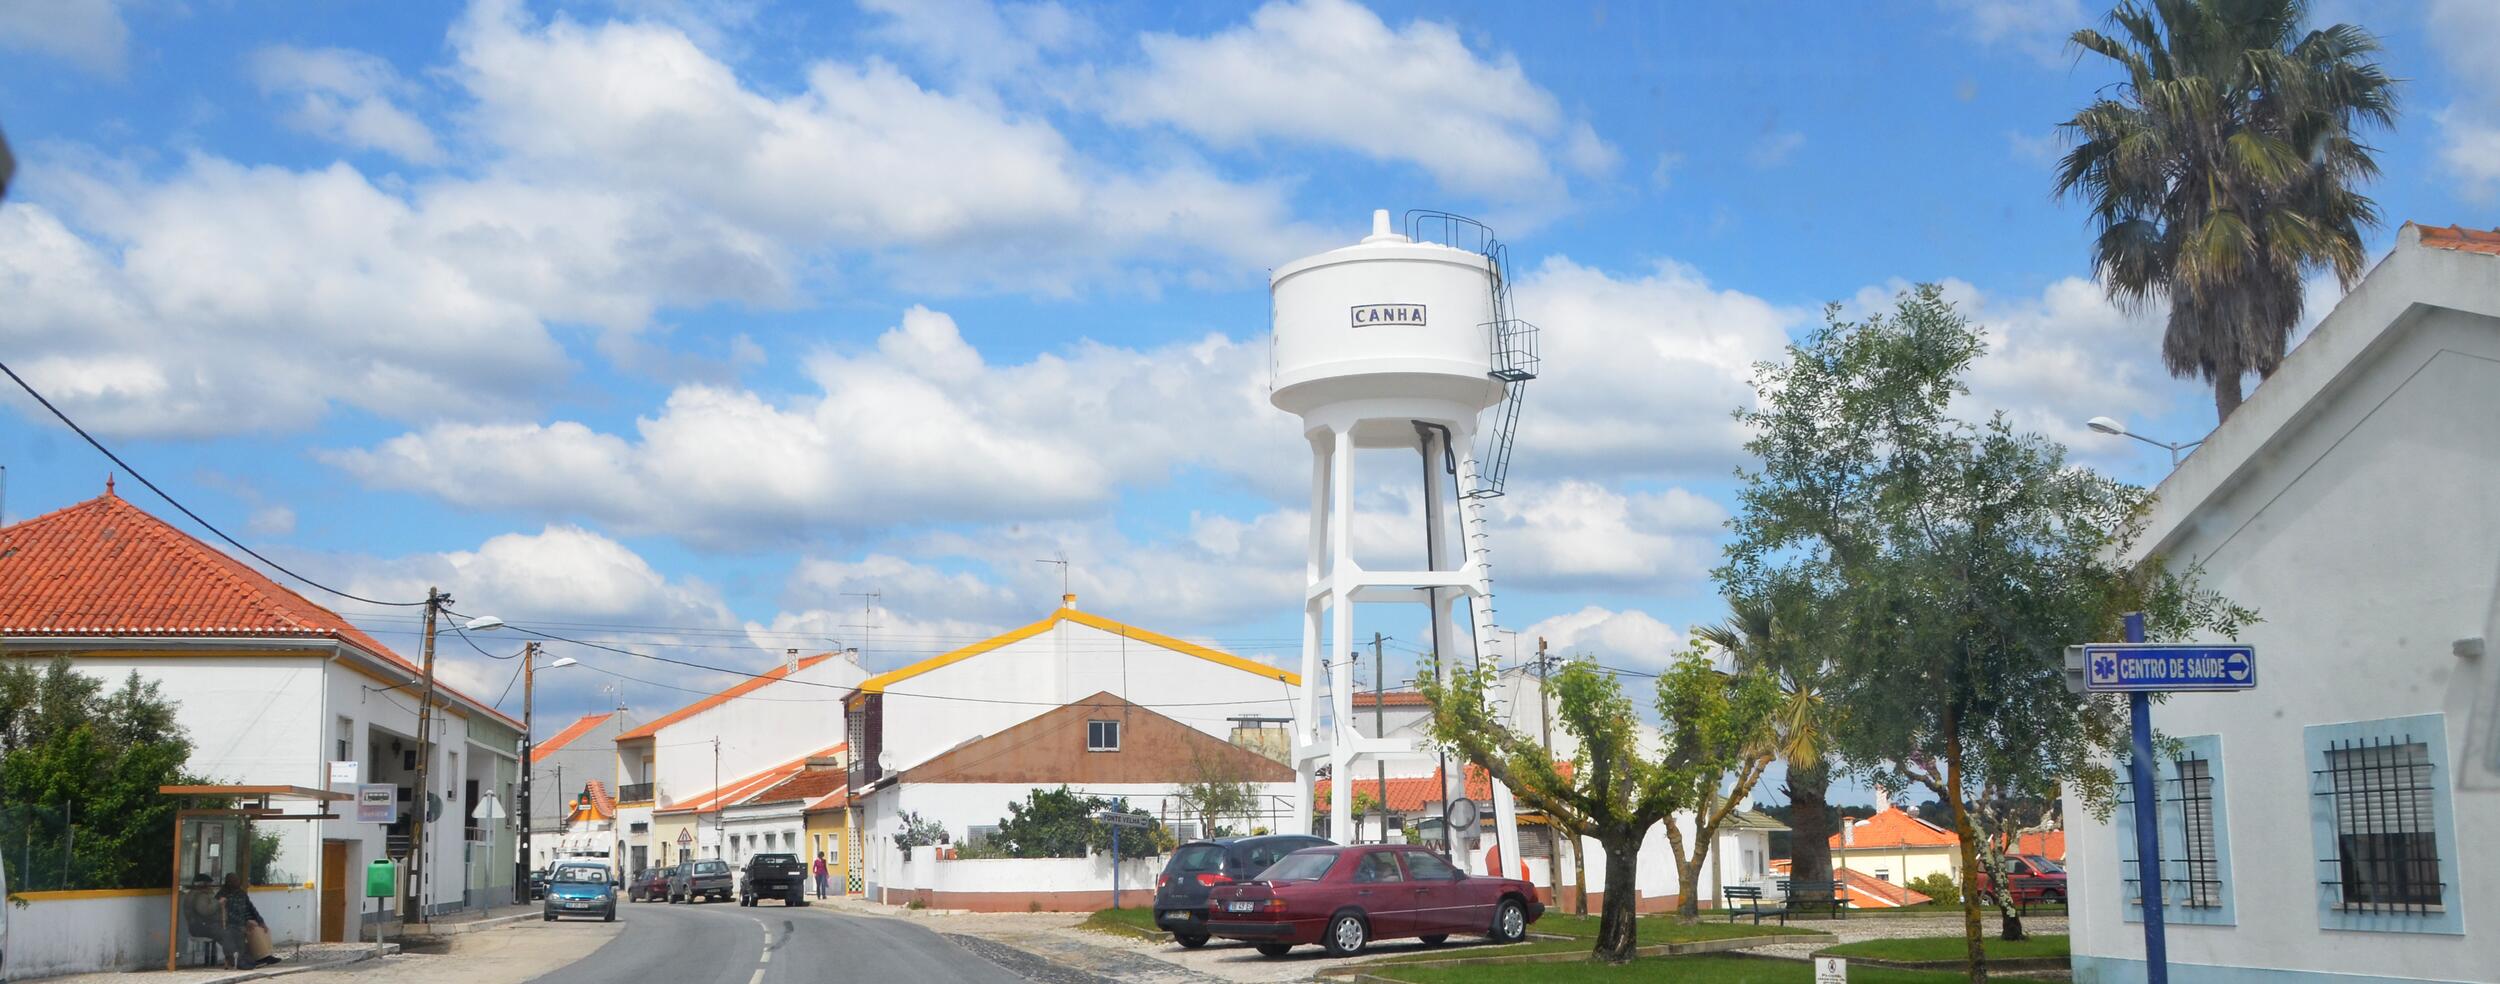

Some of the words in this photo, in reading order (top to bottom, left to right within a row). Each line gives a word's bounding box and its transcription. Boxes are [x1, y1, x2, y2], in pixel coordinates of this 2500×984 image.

[1355, 308, 1422, 322] CANHA
[2120, 657, 2166, 679] CENTRO
[2169, 657, 2185, 679] DE
[2187, 653, 2226, 679] SAÚDE
[1103, 814, 1121, 823] FONTE
[1122, 816, 1140, 824] VELHA
